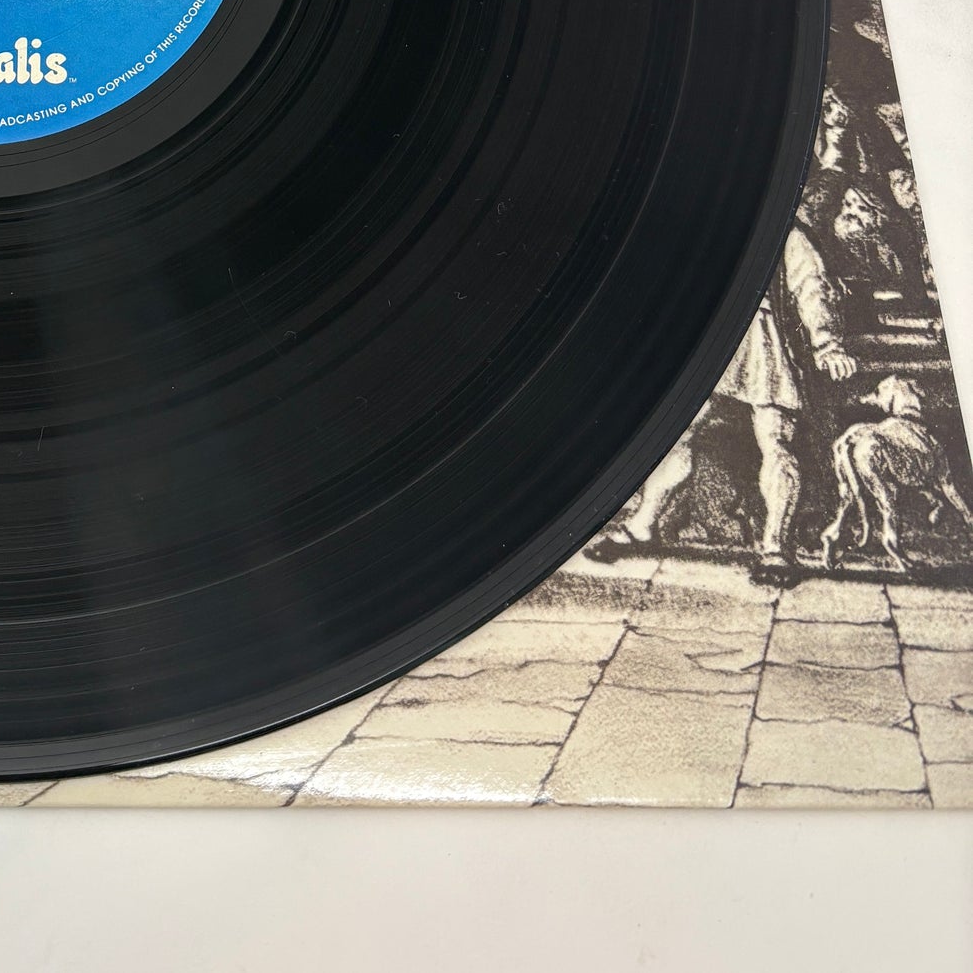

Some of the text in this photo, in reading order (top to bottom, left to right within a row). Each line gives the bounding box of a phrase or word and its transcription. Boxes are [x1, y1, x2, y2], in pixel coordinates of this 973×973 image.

[70, 93, 95, 109] AND
[97, 62, 145, 96] COPYING
[145, 50, 158, 64] OF
[157, 33, 177, 52] THIS
